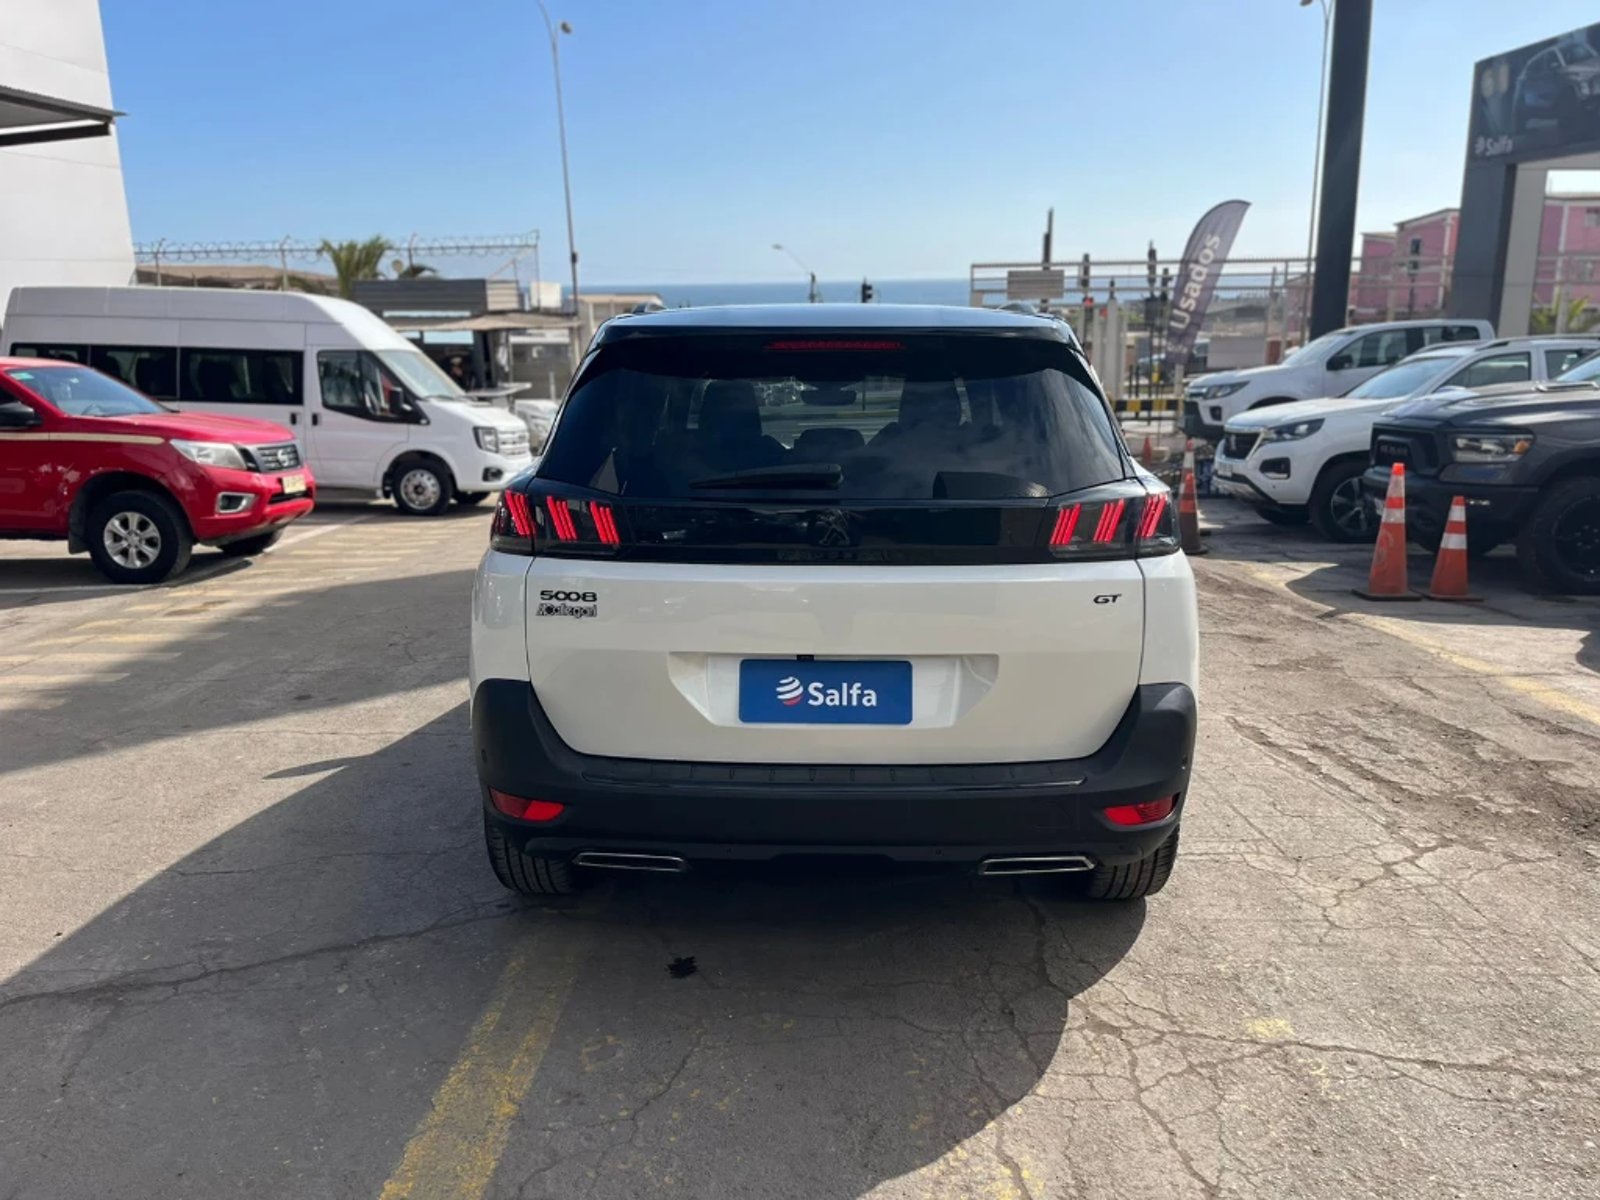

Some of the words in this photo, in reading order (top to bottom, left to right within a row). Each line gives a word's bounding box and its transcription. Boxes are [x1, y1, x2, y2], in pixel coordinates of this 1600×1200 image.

[1170, 234, 1220, 329] Usados
[540, 590, 598, 602] 5008
[1093, 593, 1122, 604] GT
[807, 682, 877, 707] Salfa
